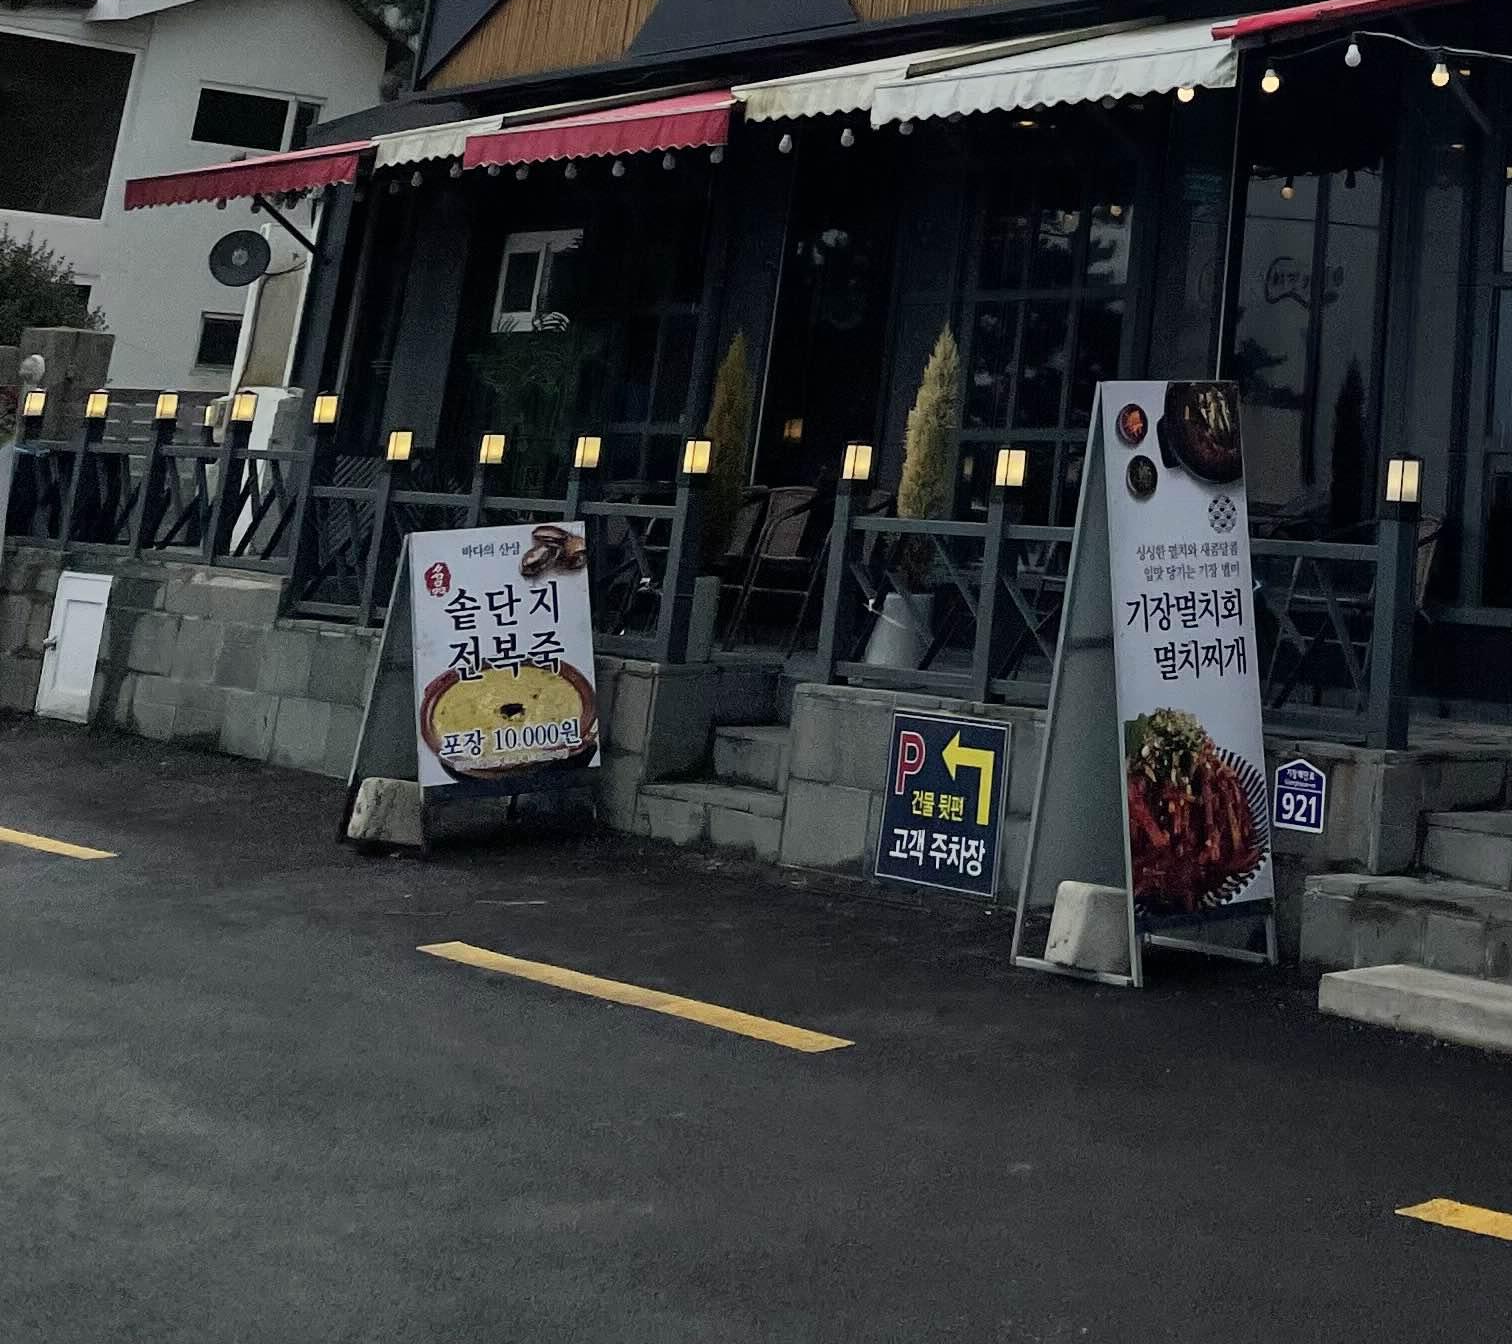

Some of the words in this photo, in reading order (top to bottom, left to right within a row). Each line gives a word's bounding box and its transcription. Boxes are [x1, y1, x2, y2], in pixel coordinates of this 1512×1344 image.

[461, 543, 495, 558] 바다의
[498, 541, 520, 556] 산삼
[1136, 543, 1165, 561] 싱싱한
[444, 580, 560, 631] 솥단지
[1125, 587, 1243, 633] 기장멸치회
[448, 630, 566, 681] 전복죽
[1153, 636, 1247, 681] 멸치찌개
[441, 730, 483, 756] 포장
[895, 730, 926, 795] P
[911, 790, 935, 817] 건물
[938, 794, 965, 822] 뒷편
[1281, 792, 1317, 824] 921
[889, 828, 926, 866] 고객
[929, 832, 986, 877] 주차장
